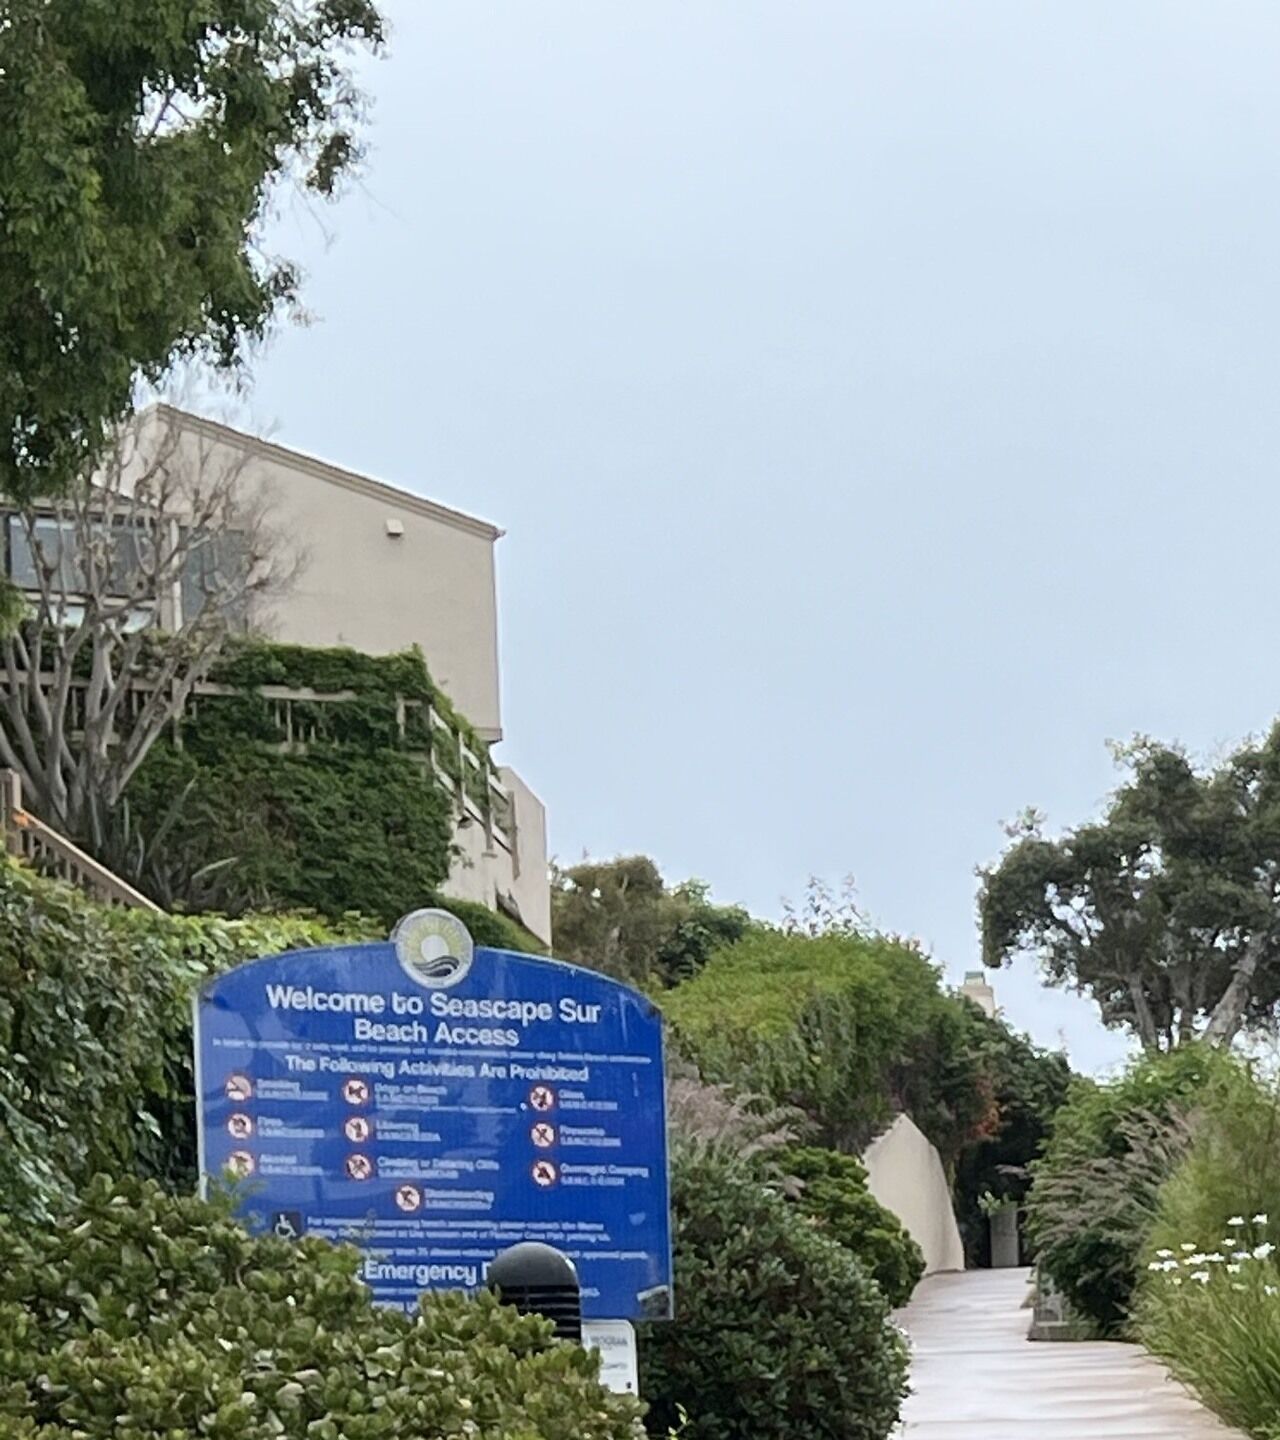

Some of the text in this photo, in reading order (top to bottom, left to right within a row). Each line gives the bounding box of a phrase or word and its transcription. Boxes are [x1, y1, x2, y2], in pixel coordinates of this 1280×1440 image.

[267, 984, 601, 1026] Welcome to Seascape Sur
[355, 1019, 519, 1047] Beach Access
[285, 1055, 588, 1082] The Following Activities Are Prohibited
